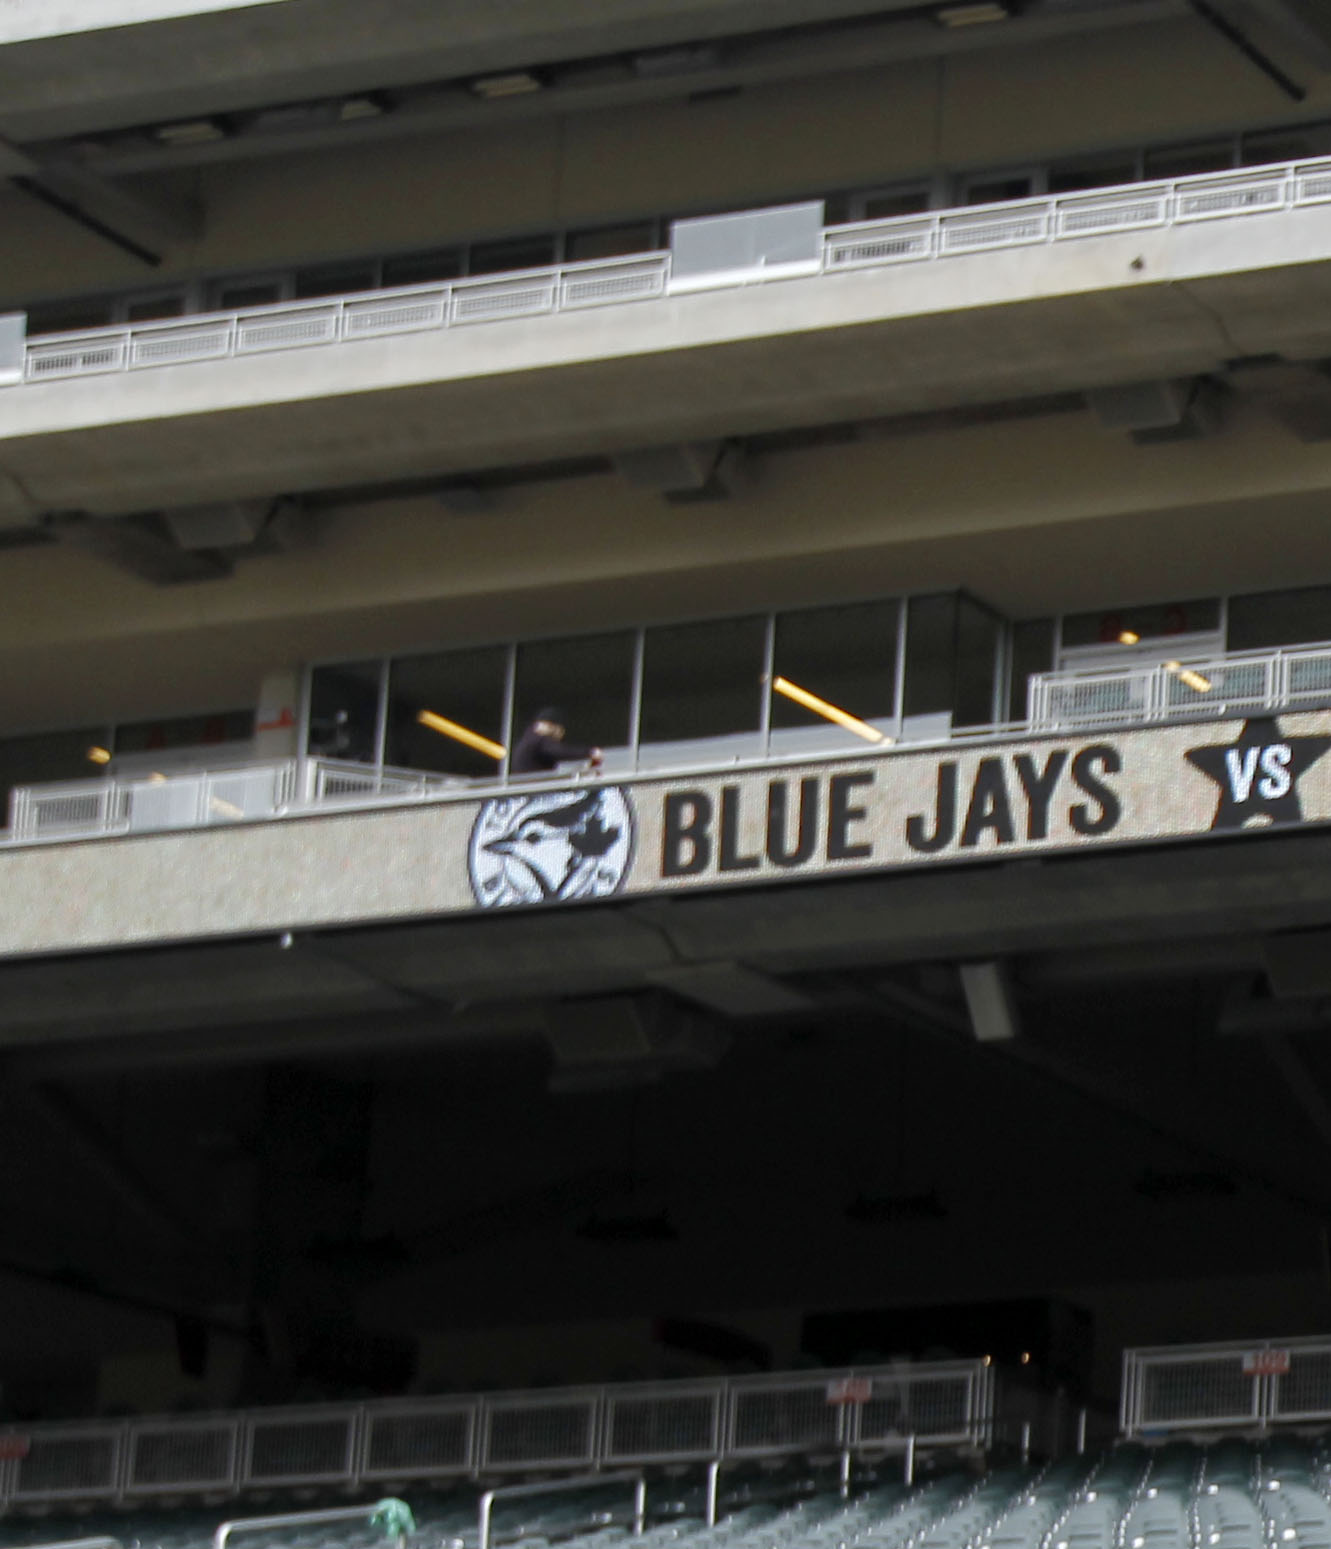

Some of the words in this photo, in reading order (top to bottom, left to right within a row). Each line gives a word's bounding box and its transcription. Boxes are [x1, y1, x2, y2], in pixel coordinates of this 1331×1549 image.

[661, 770, 875, 878] BLUE
[906, 743, 1121, 852] JAYS
[1225, 743, 1292, 804] VS
